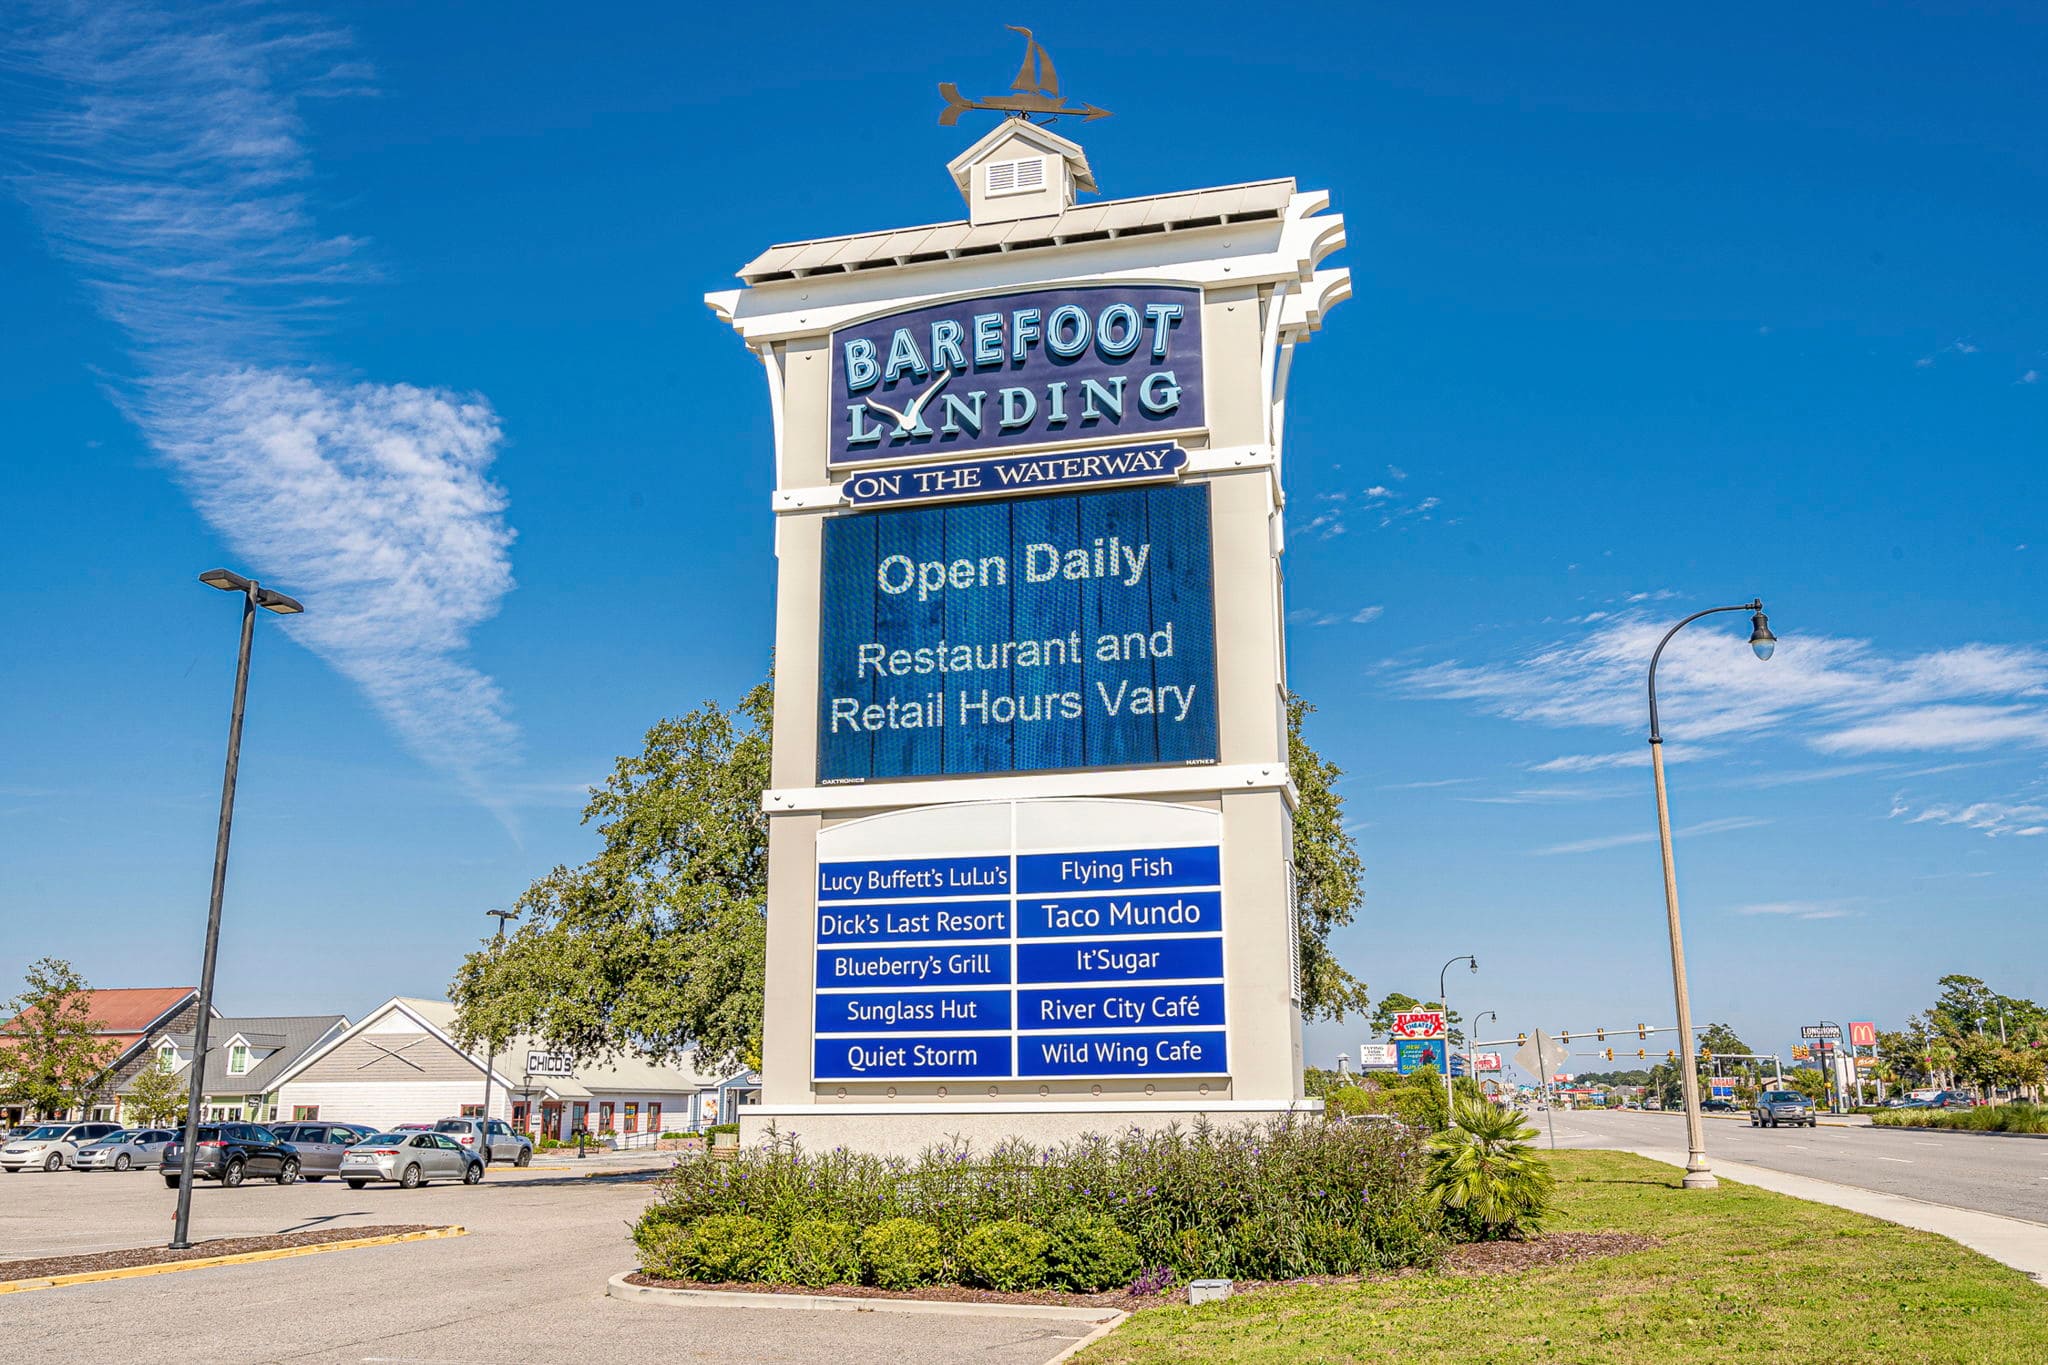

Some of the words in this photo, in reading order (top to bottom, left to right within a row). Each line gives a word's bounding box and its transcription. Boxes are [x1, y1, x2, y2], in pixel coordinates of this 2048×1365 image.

[845, 304, 1184, 391] BAREFOOT
[847, 371, 1183, 443] LANDING
[854, 475, 902, 498] ON
[914, 467, 981, 491] THE
[995, 449, 1170, 484] WATERWAY
[878, 555, 1005, 601] Open
[1027, 537, 1150, 585] Daily
[859, 631, 1081, 677] Restaurant
[1096, 622, 1172, 661] and
[832, 693, 942, 732] Retail
[961, 690, 1081, 724] Hours
[1097, 680, 1195, 721] Vary
[822, 874, 862, 894] Lucy
[869, 869, 942, 889] Buffett's
[951, 867, 1007, 886] LuLu's
[1063, 861, 1123, 883] Flying
[1132, 857, 1172, 876] Fish
[822, 914, 878, 935] Dick's
[888, 914, 929, 932] Last
[938, 912, 1005, 931] Resort
[1042, 905, 1099, 928] Taco
[1111, 900, 1200, 925] Mundo
[836, 956, 941, 979] Blueberry's
[949, 954, 990, 973] Grill
[1078, 949, 1159, 973] It'Sugar
[848, 1001, 933, 1024] Sunglass
[942, 1000, 976, 1018] Hut
[1042, 1000, 1095, 1019] River
[1104, 998, 1145, 1023] City
[1152, 996, 1199, 1017] Café
[1392, 1014, 1445, 1037] ALABAMA
[1802, 1027, 1840, 1035] LONGHORN
[529, 1054, 571, 1072] CHICO'S
[849, 1046, 906, 1071] Quiet
[914, 1045, 976, 1065] Storm
[1042, 1044, 1088, 1063] Wild
[1095, 1043, 1147, 1066] Wing
[1157, 1041, 1201, 1060] Cafe
